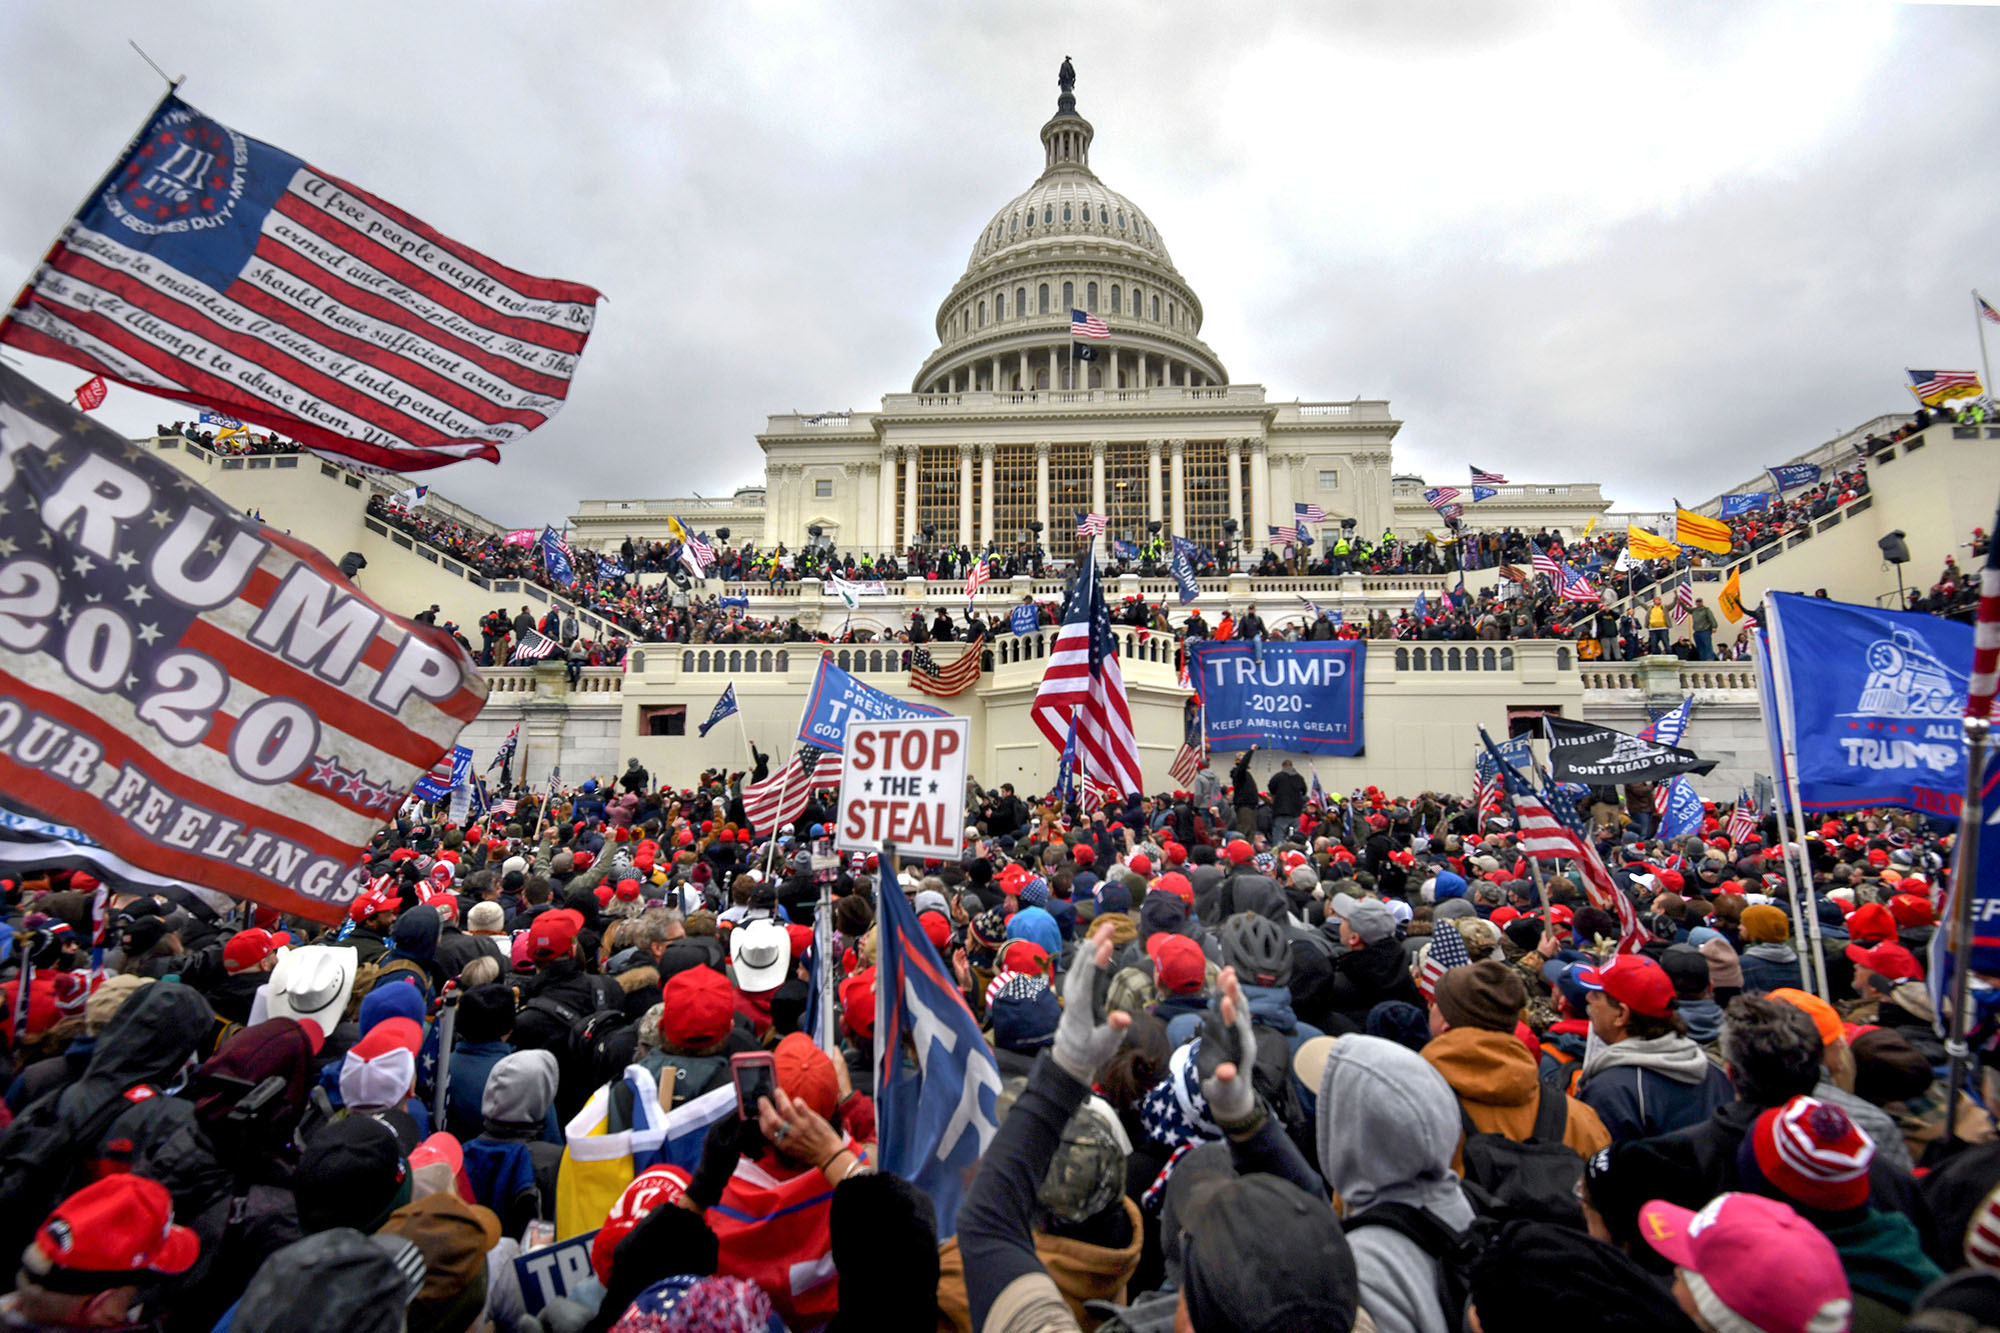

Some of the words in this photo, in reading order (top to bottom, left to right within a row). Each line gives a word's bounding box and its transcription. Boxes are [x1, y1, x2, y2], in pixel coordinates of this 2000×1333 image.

[144, 174, 193, 202] 1776
[190, 206, 232, 230] DUTY
[304, 178, 326, 197] A
[324, 193, 365, 222] free
[367, 221, 434, 263] people
[437, 261, 497, 298] ought
[274, 225, 348, 270] armed
[347, 265, 388, 288] and
[387, 285, 495, 350] disciplined,
[500, 340, 541, 362] But
[155, 273, 244, 327] maintain
[267, 329, 326, 363] status
[329, 360, 354, 379] of
[251, 267, 323, 310] should
[322, 304, 369, 334] have
[370, 328, 461, 374] sufficient
[462, 371, 513, 402] arms
[125, 308, 209, 362] Attempt
[210, 354, 233, 373] to
[238, 369, 295, 406] abuse
[298, 399, 354, 437] them,
[209, 415, 237, 428] 2020
[0, 560, 321, 782] 2020
[1206, 656, 1346, 687] TRUMP
[814, 723, 841, 739] GOD
[1211, 718, 1243, 731] KEEP
[1247, 718, 1300, 731] AMERICA
[1303, 721, 1349, 733] GREAT!
[1558, 732, 1610, 746] LIBERTY
[1924, 724, 1959, 740] ALL
[852, 728, 960, 772] STOP
[1568, 764, 1606, 775] DONT
[1608, 760, 1651, 774] TREAD
[1654, 753, 1676, 765] ON
[1840, 737, 1959, 772] TRUMP
[879, 776, 923, 796] THE
[106, 760, 366, 904] FEELINGS
[846, 799, 954, 847] STEAL
